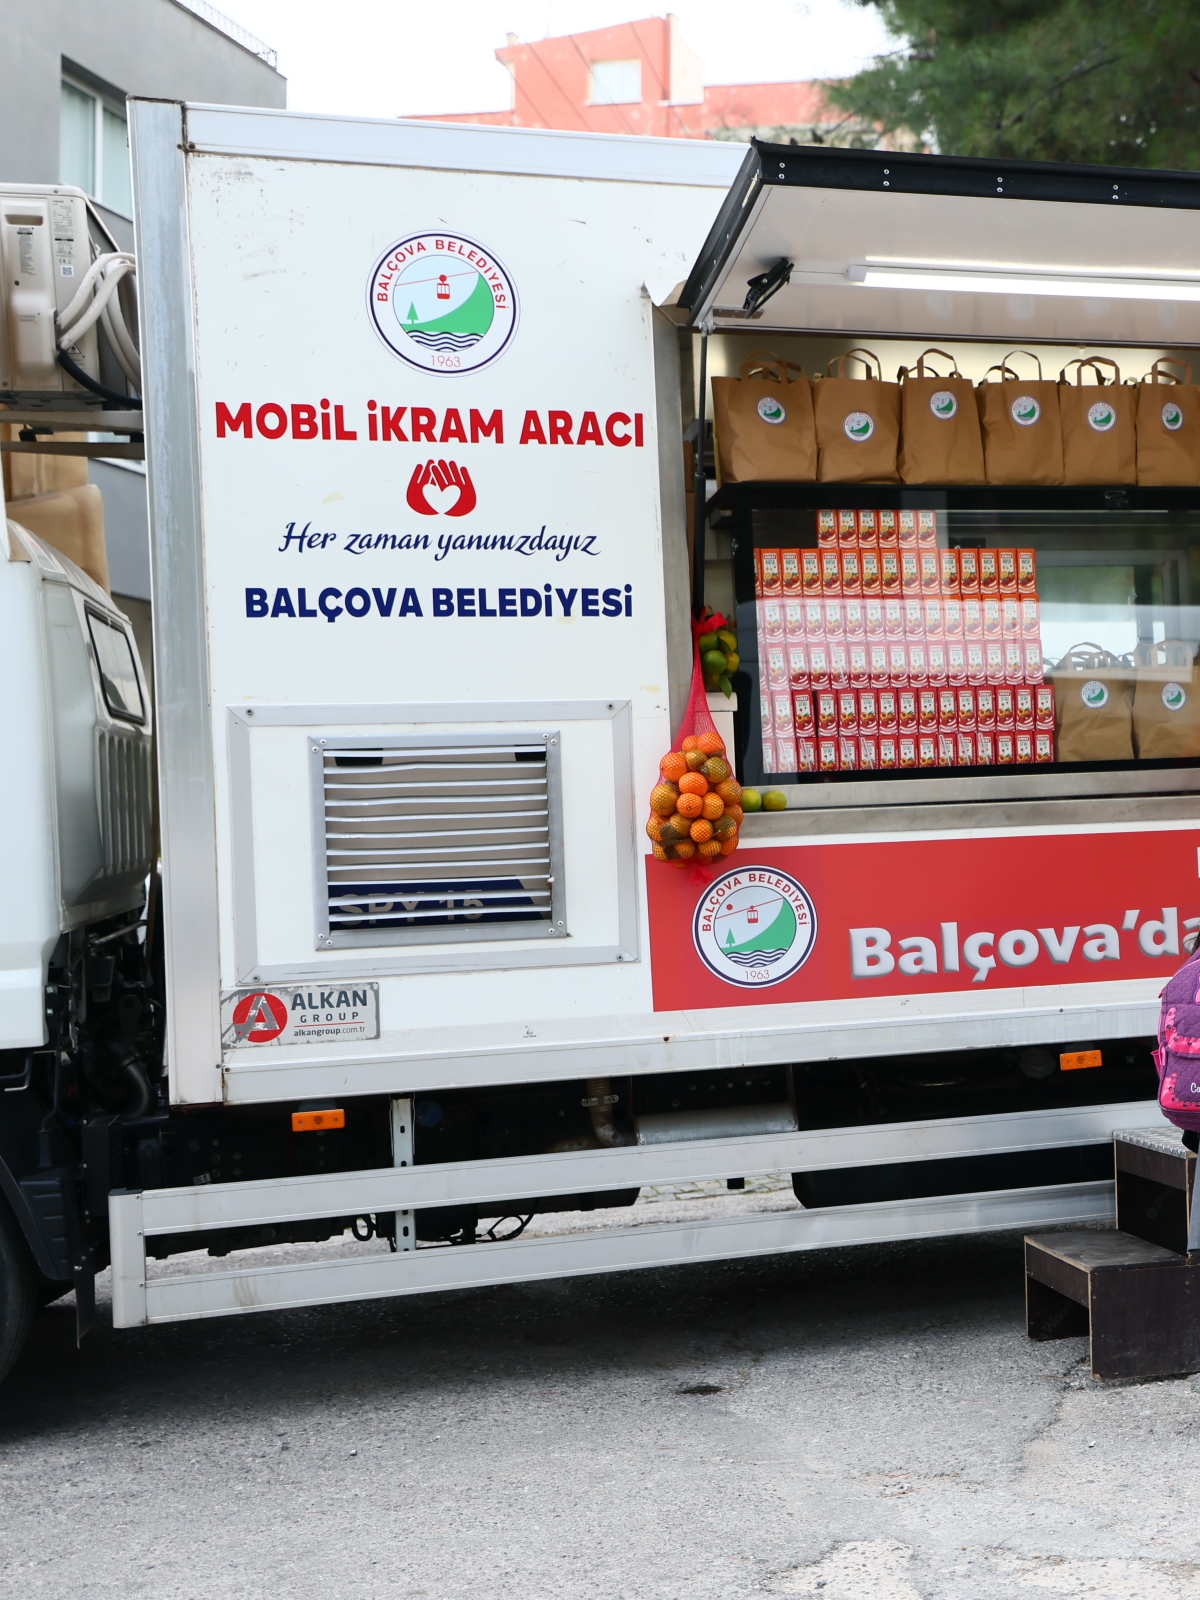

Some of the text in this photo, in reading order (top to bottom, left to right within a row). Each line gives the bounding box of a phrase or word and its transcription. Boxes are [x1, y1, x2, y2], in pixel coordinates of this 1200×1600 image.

[377, 239, 510, 309] BALÇOVA BELEDİYESİ
[431, 355, 462, 368] 1963
[519, 410, 645, 447] ARACI
[278, 521, 602, 562] Her zaman yanınızdayız
[245, 587, 424, 623] BALÇOVA
[702, 873, 810, 932] BALÇOVA BELEDİYESİ
[745, 970, 770, 981] 1963
[291, 989, 368, 1011] ALKAN
[300, 1011, 359, 1023] GROUP
[293, 1026, 366, 1038] alkangroup.com.tr
